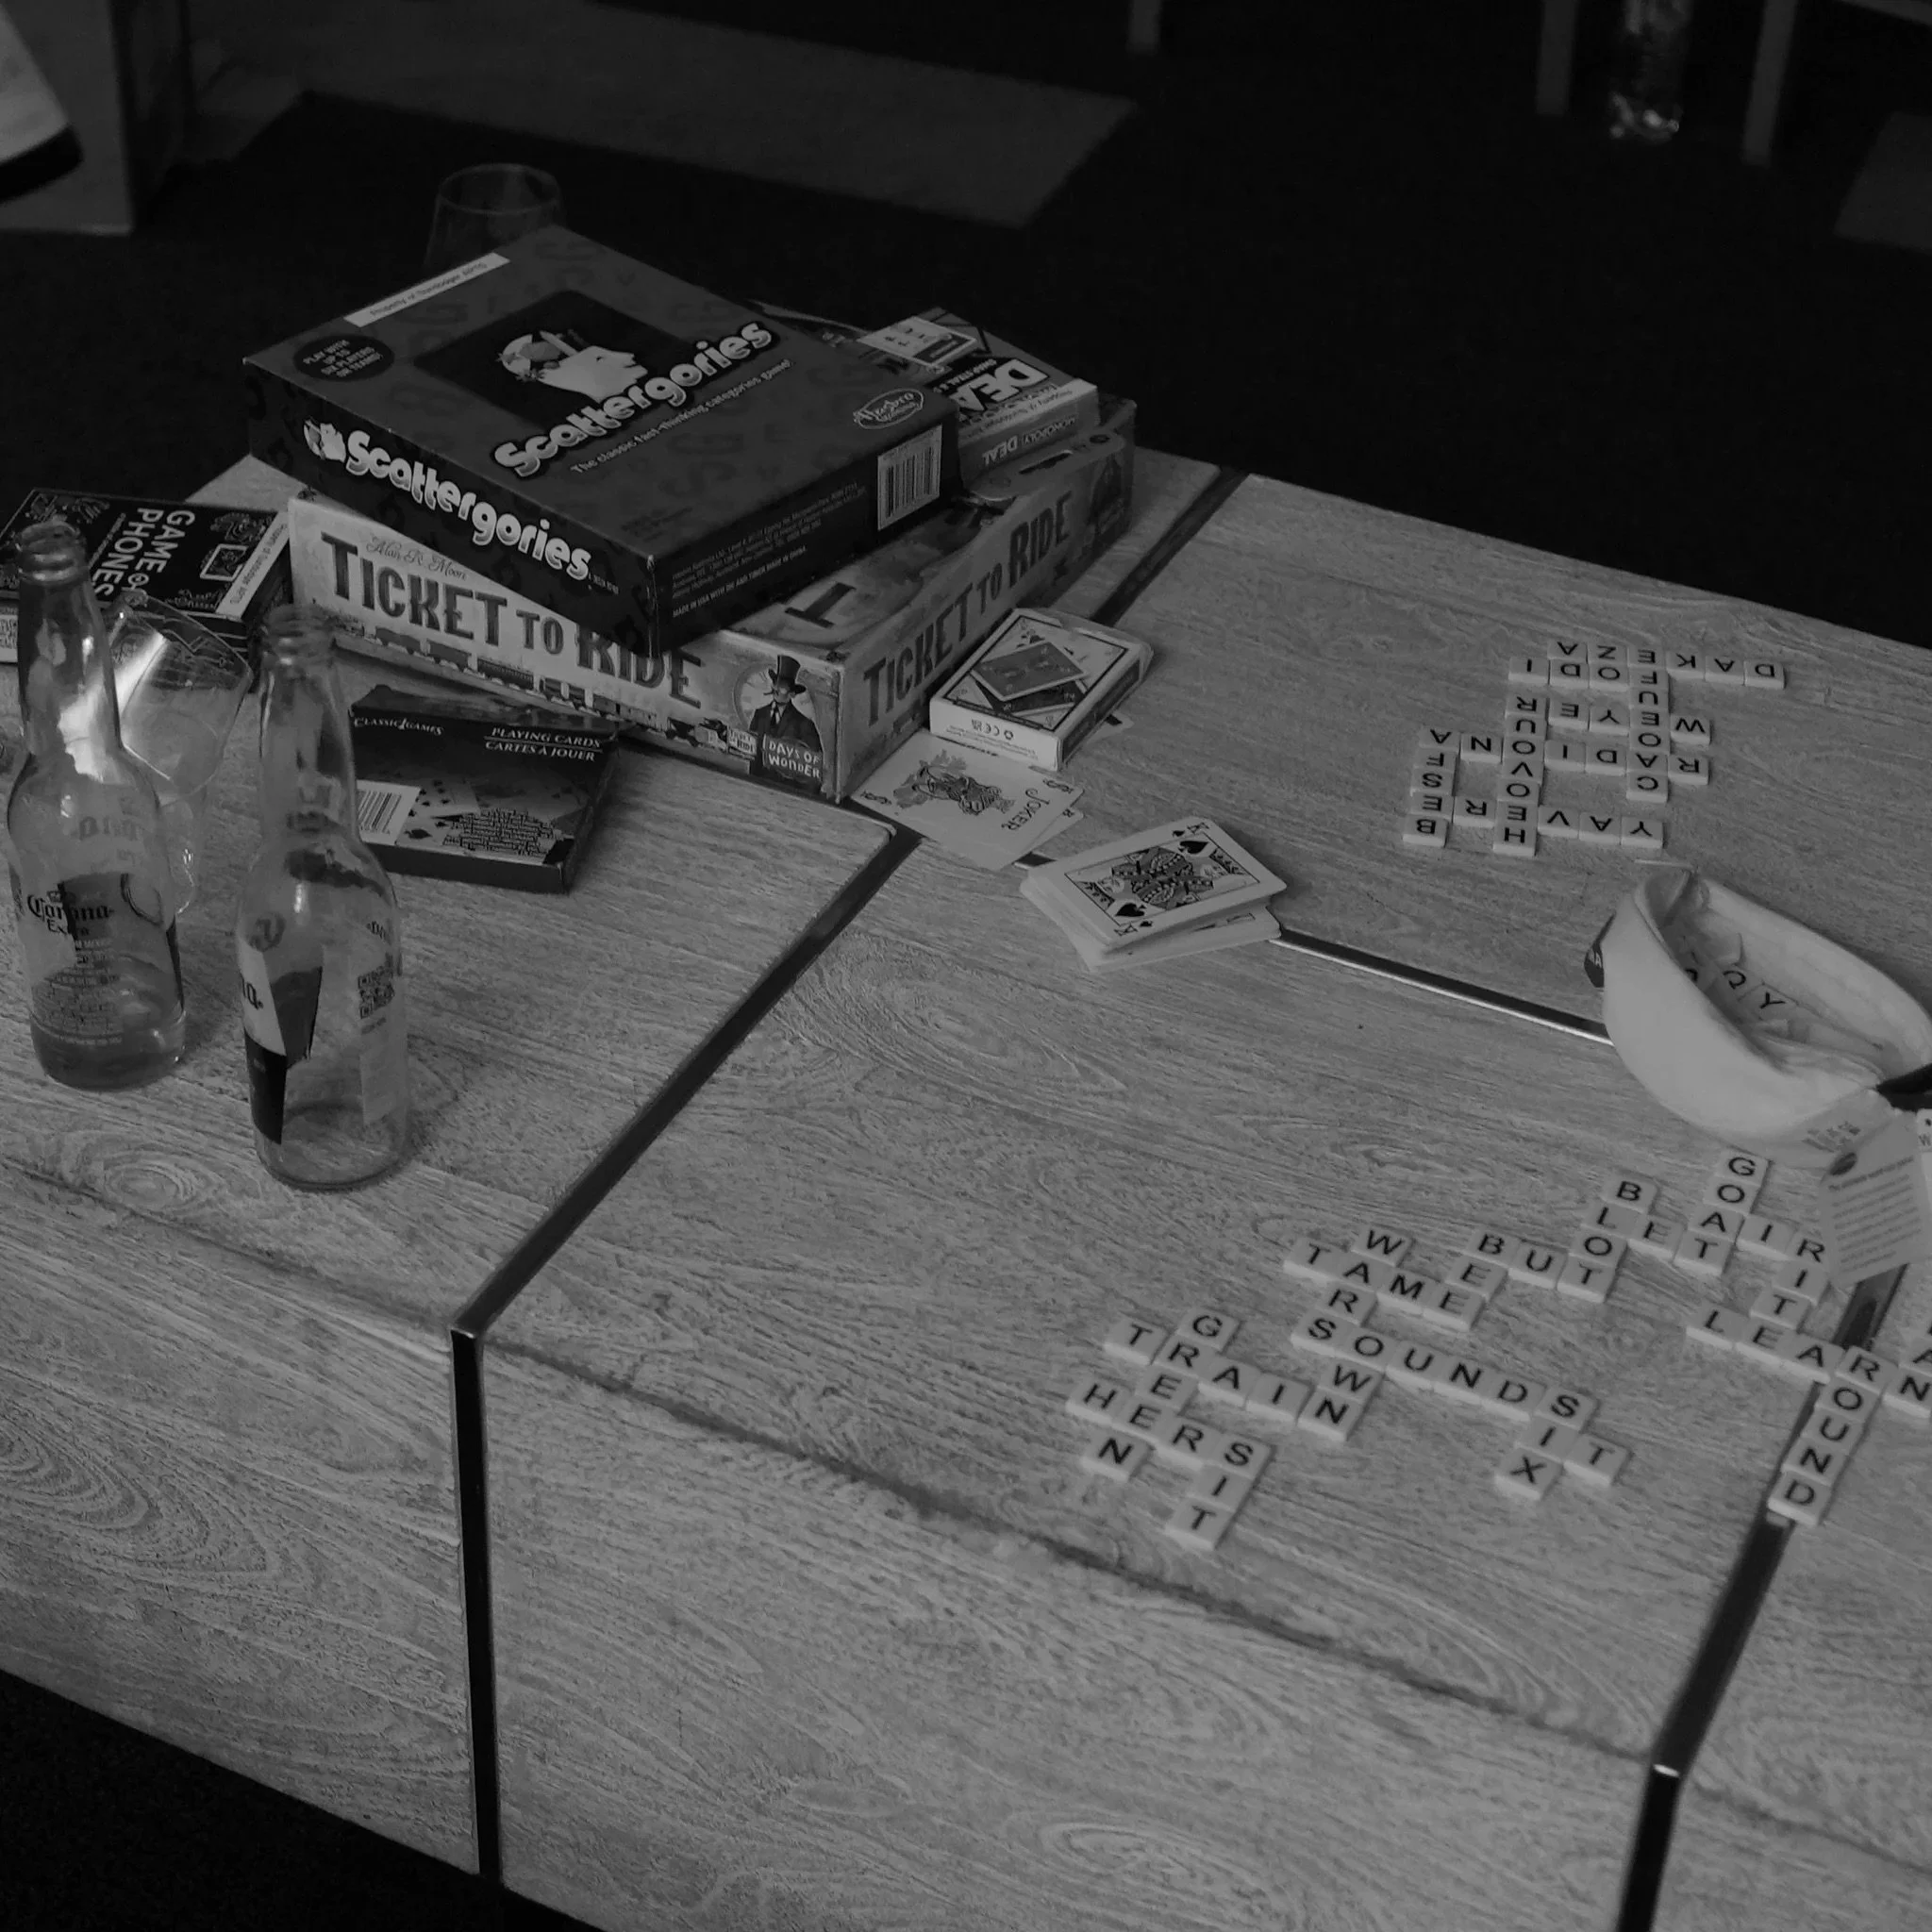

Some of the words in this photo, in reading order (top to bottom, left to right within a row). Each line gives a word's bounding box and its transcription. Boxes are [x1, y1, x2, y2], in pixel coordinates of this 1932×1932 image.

[492, 322, 774, 477] Scattergories
[949, 358, 1050, 411] DEA
[982, 435, 1018, 466] DEAL
[345, 428, 592, 581] Scattergories
[92, 508, 164, 596] PHONES
[134, 509, 196, 574] GAME
[321, 531, 508, 647] TICKET
[516, 609, 564, 654] TO
[576, 625, 702, 709] RIDE
[863, 582, 974, 727] TICKET
[976, 562, 1003, 614] TO
[1008, 490, 1073, 589] RIDE
[485, 741, 537, 755] CARTES
[550, 746, 596, 762] JOUER
[491, 727, 551, 742] PLAYING
[554, 734, 603, 748] CARDS
[769, 741, 801, 758] DAYS
[804, 751, 822, 764] OF
[1001, 787, 1050, 831] JOKER
